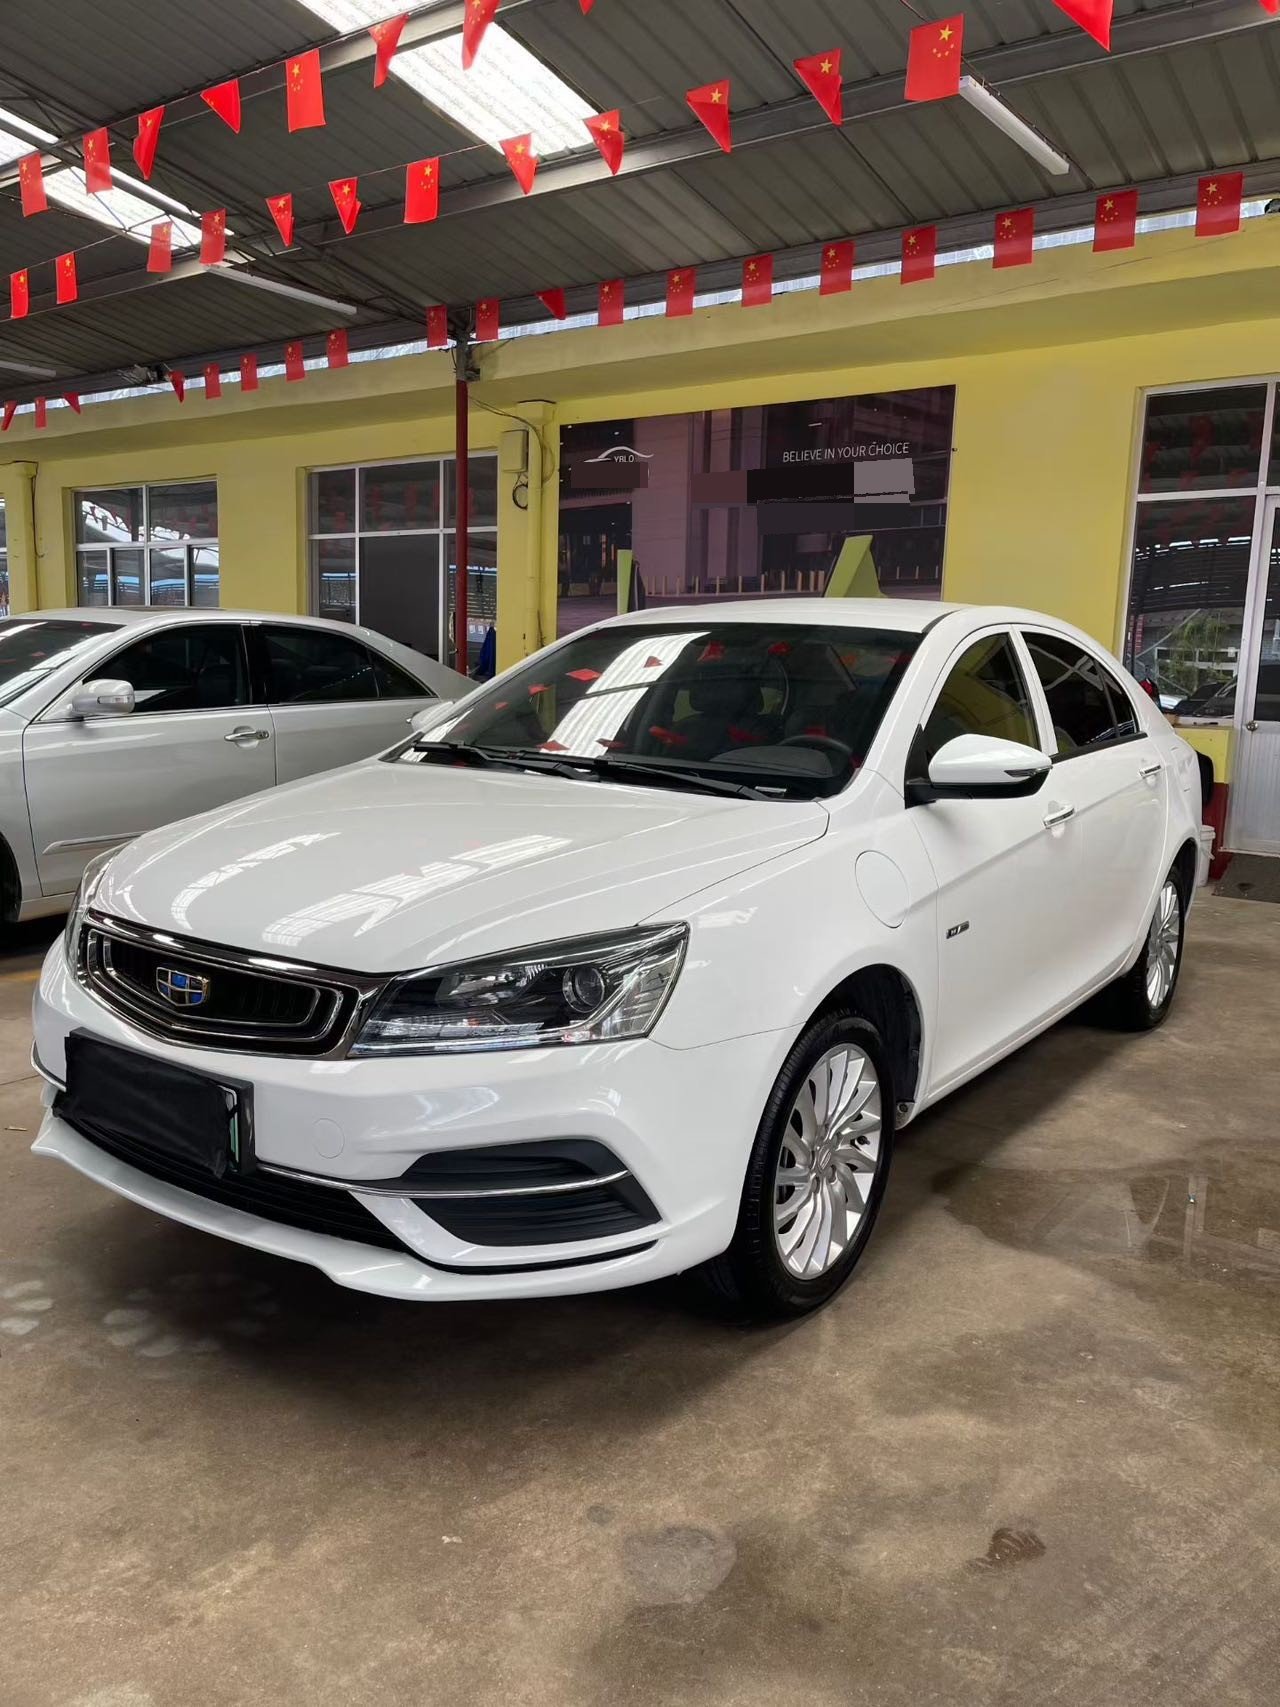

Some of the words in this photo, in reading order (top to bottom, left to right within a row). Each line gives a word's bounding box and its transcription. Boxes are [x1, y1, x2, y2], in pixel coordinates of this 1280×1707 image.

[782, 449, 822, 462] BELIEVE
[824, 447, 835, 459] IN
[837, 445, 866, 458] YOUR
[868, 442, 910, 456] CHOICE
